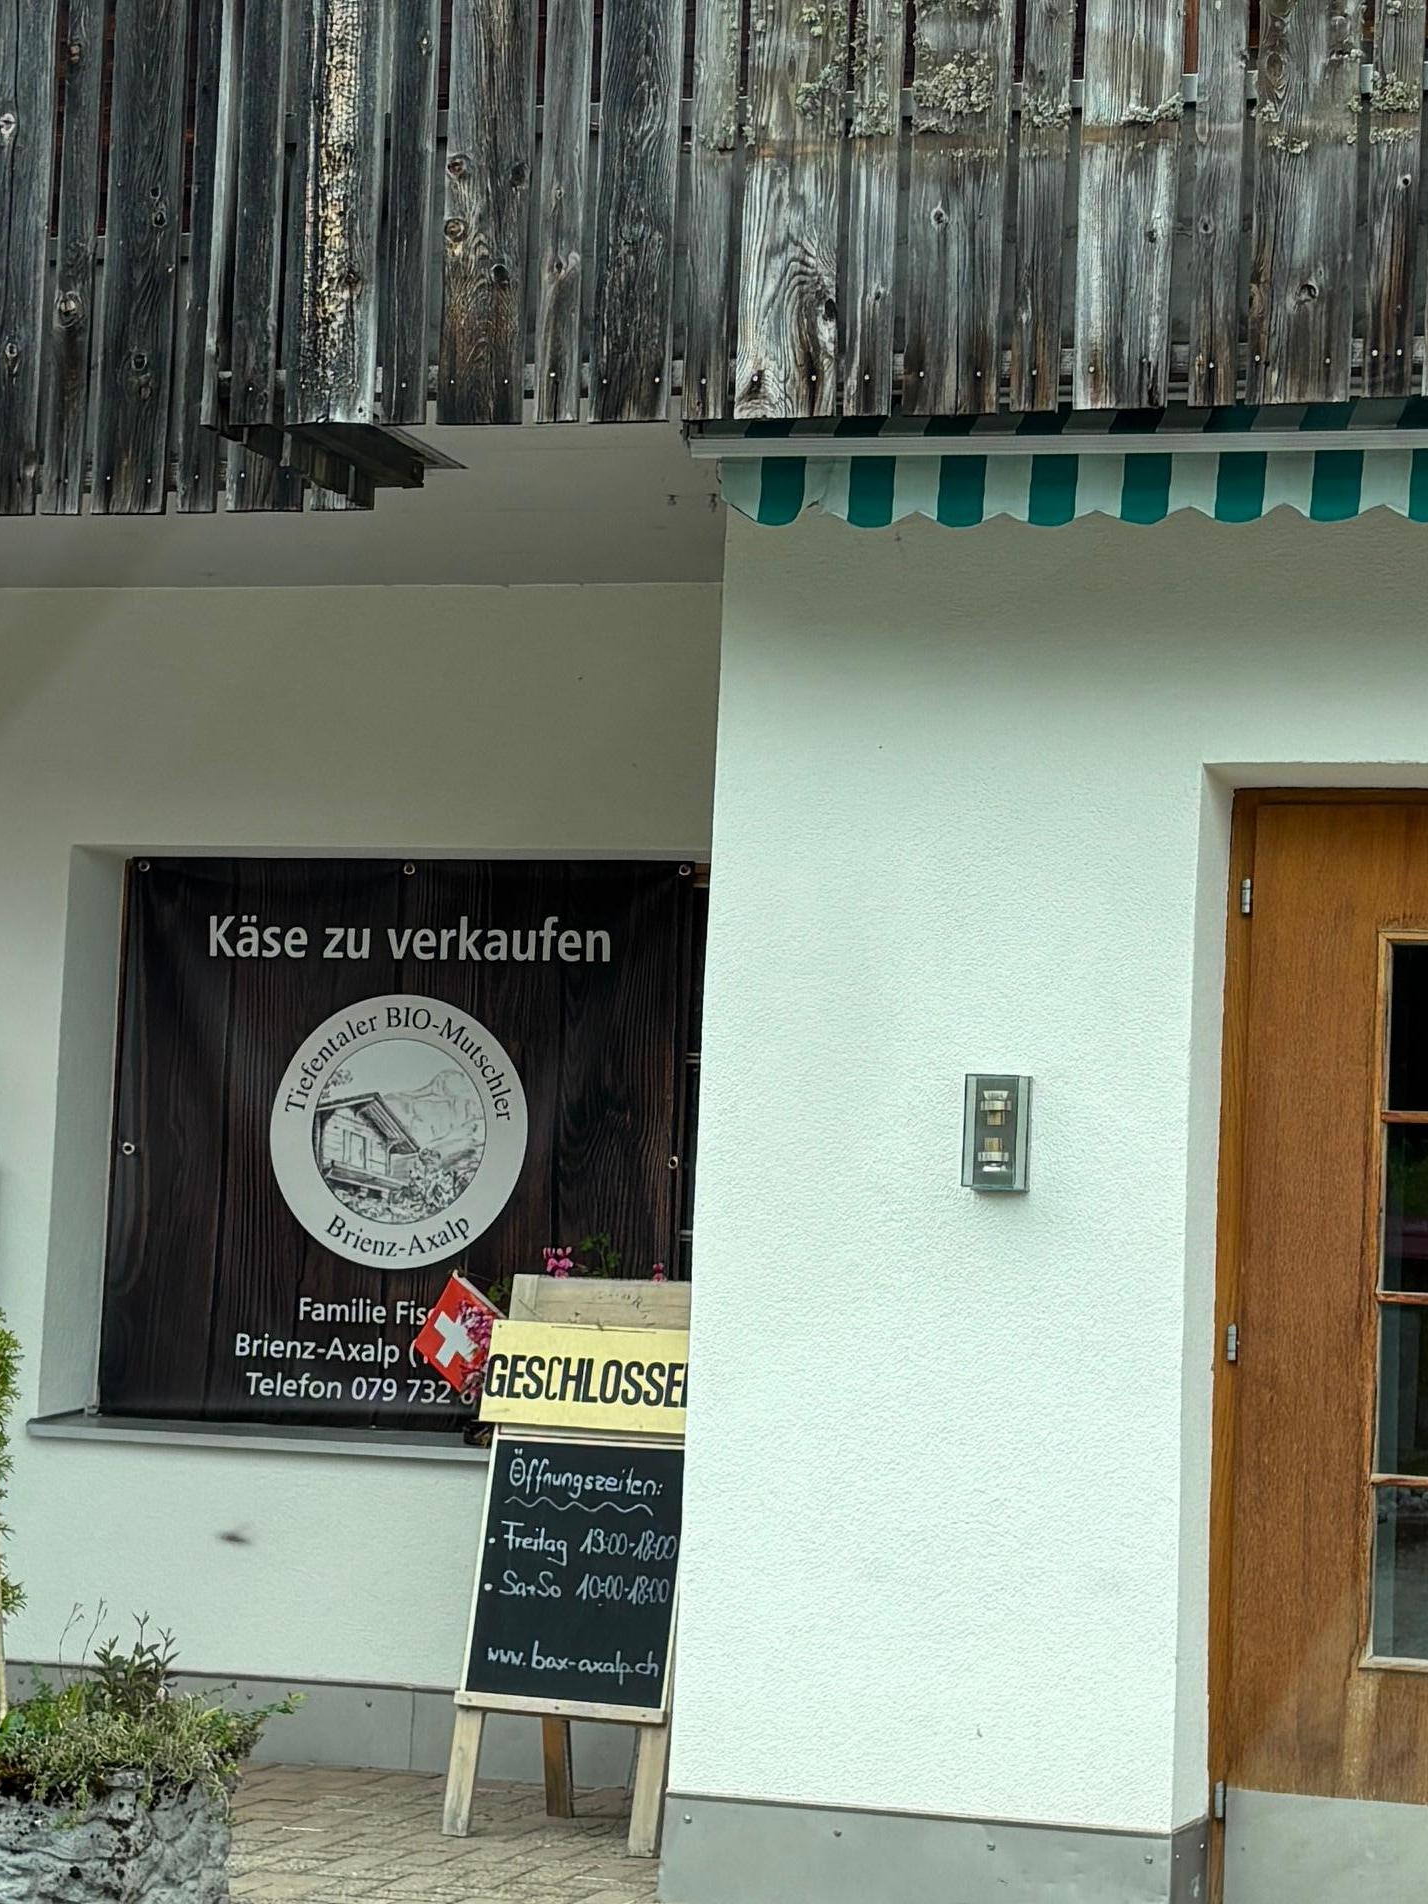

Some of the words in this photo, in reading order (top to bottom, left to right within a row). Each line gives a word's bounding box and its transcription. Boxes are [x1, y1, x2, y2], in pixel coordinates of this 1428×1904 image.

[208, 915, 308, 960] Käse
[323, 927, 371, 960] zu
[386, 916, 612, 963] verkaufen
[284, 1015, 379, 1115] Tiefentaler
[385, 1005, 512, 1122] BIO-Mutschler
[324, 1214, 470, 1257] Brienz-Axalp
[298, 1296, 387, 1325] Familie
[234, 1333, 400, 1369] Brienz-Axalp
[245, 1371, 342, 1400] Telefon
[351, 1376, 398, 1402] 079
[406, 1379, 452, 1404] 732
[484, 1352, 689, 1408] GESCHLOSSE
[509, 1448, 663, 1498] Öffnungszeiten:
[501, 1520, 568, 1567] Freitag
[579, 1528, 677, 1561] 13:00-18:00
[575, 1573, 670, 1605] 10:00-18:00
